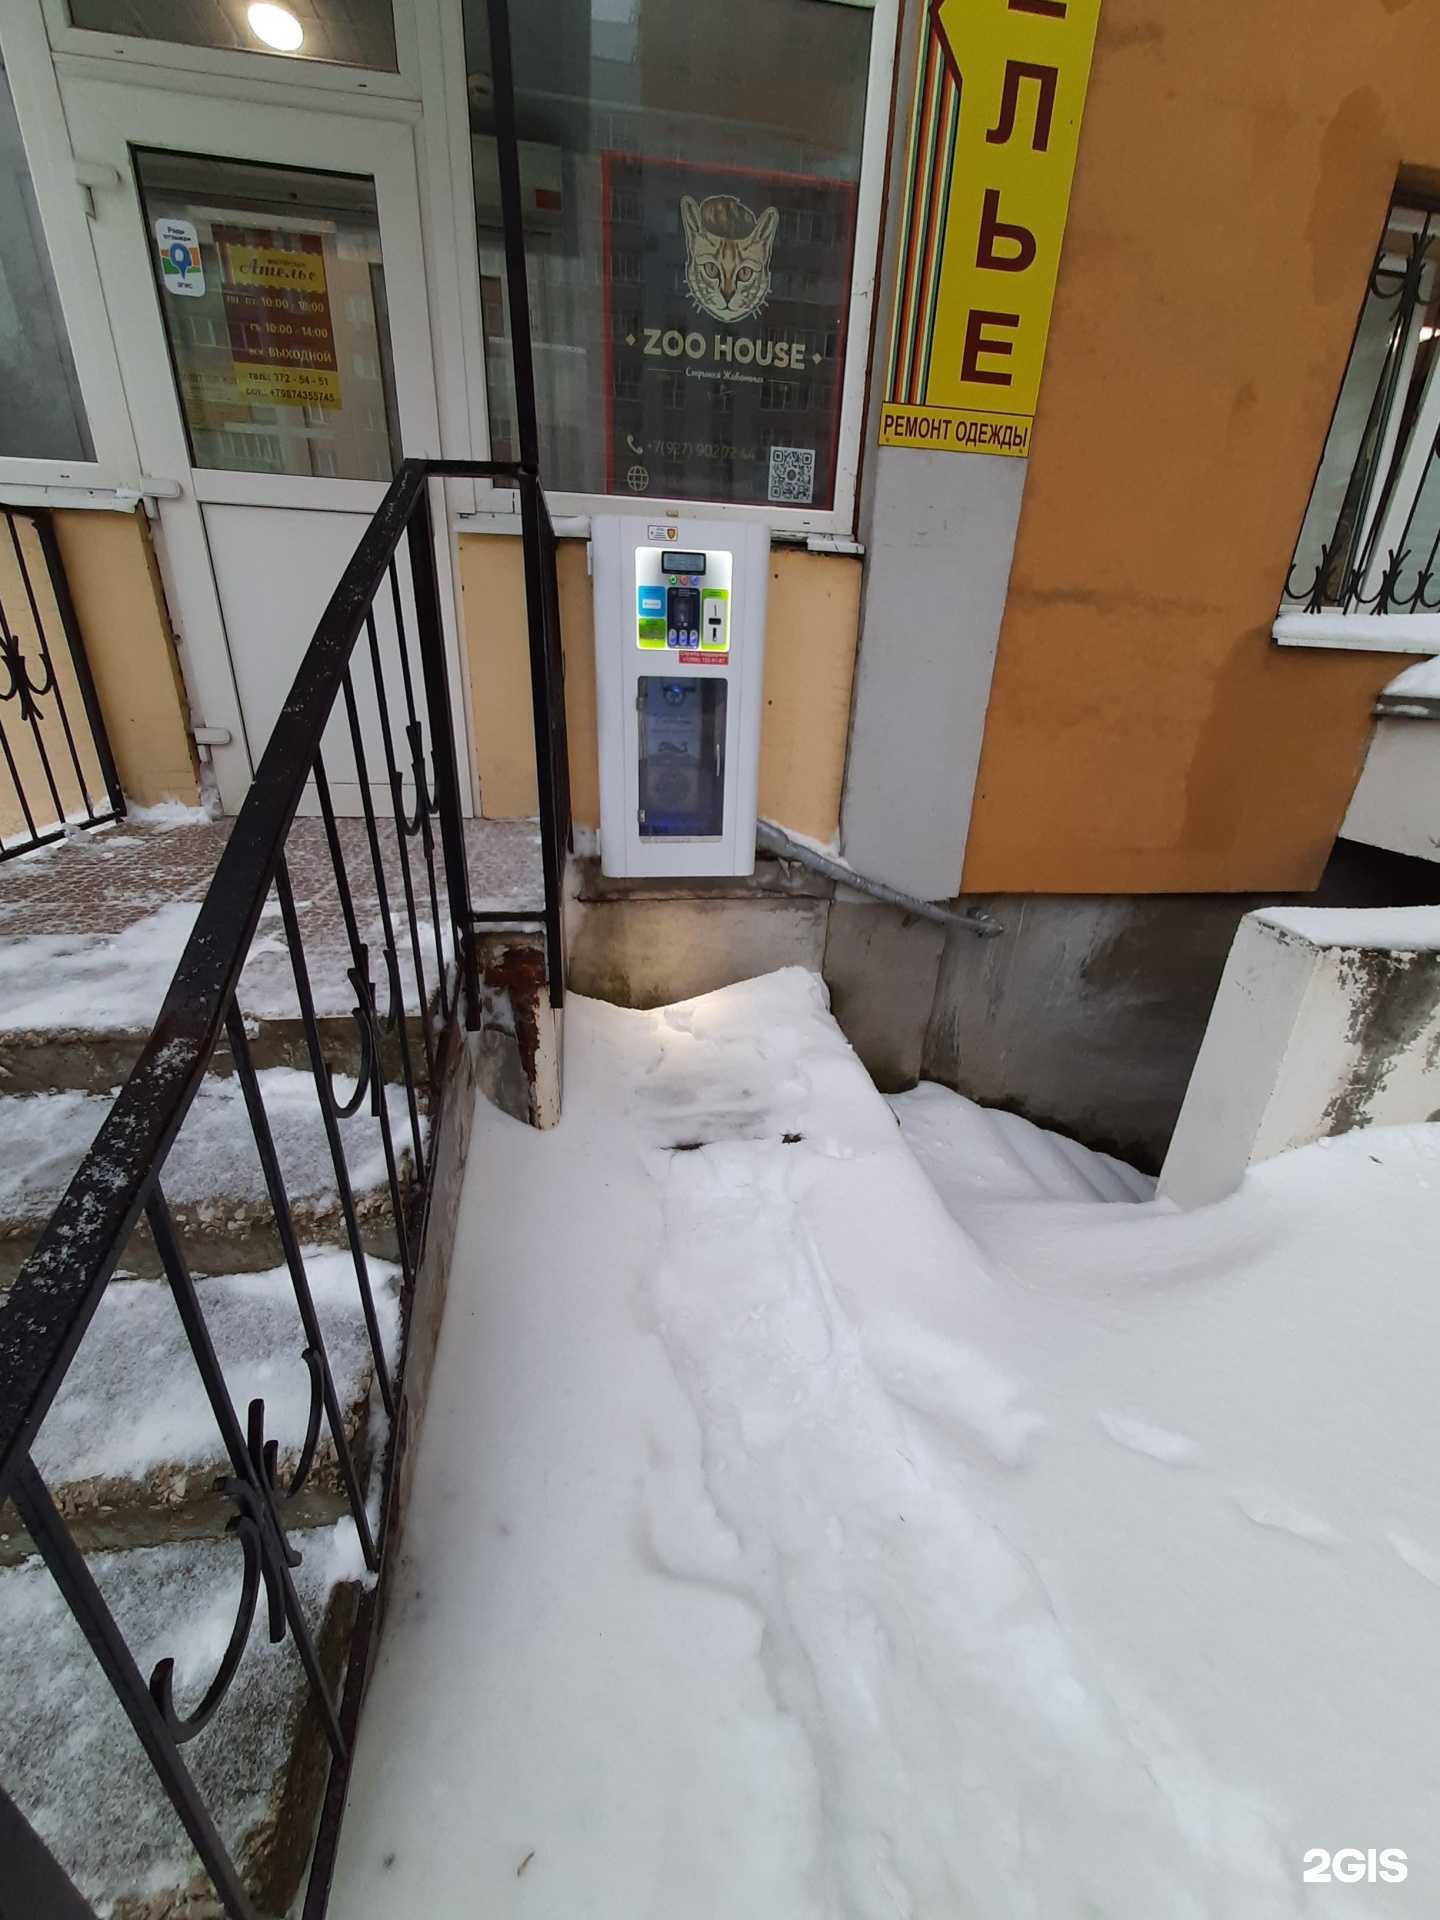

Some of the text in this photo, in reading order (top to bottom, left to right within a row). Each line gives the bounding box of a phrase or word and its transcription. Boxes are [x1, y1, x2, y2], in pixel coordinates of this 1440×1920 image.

[960, 0, 1067, 386] ЛЬЕ
[643, 328, 806, 370] ZOO HOUSE
[884, 414, 1028, 450] РЕМОНТ ОДЕЖДЫ
